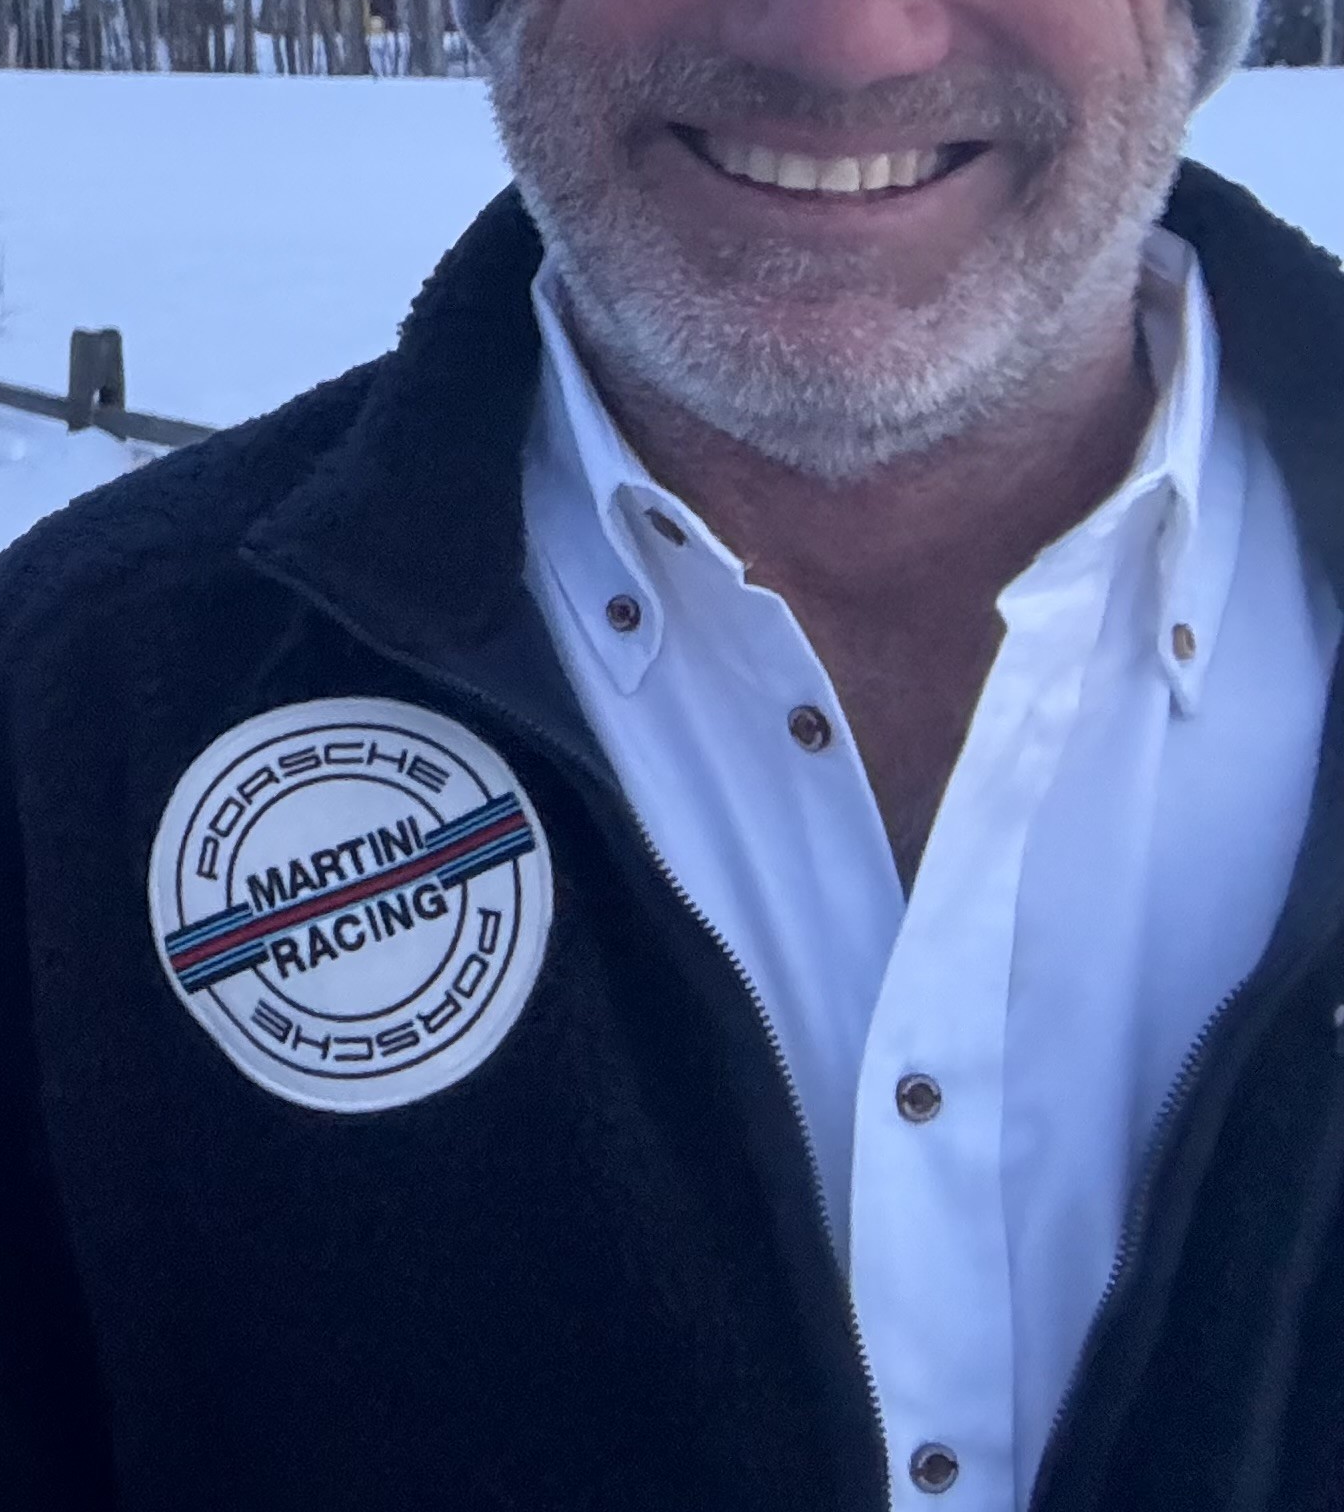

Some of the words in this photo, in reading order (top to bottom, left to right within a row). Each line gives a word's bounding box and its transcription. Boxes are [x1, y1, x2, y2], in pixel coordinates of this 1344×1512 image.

[197, 740, 451, 881] PORSCHE
[246, 816, 424, 912] MARTINI
[250, 907, 503, 1062] PORSCHE
[269, 886, 448, 980] RACING
